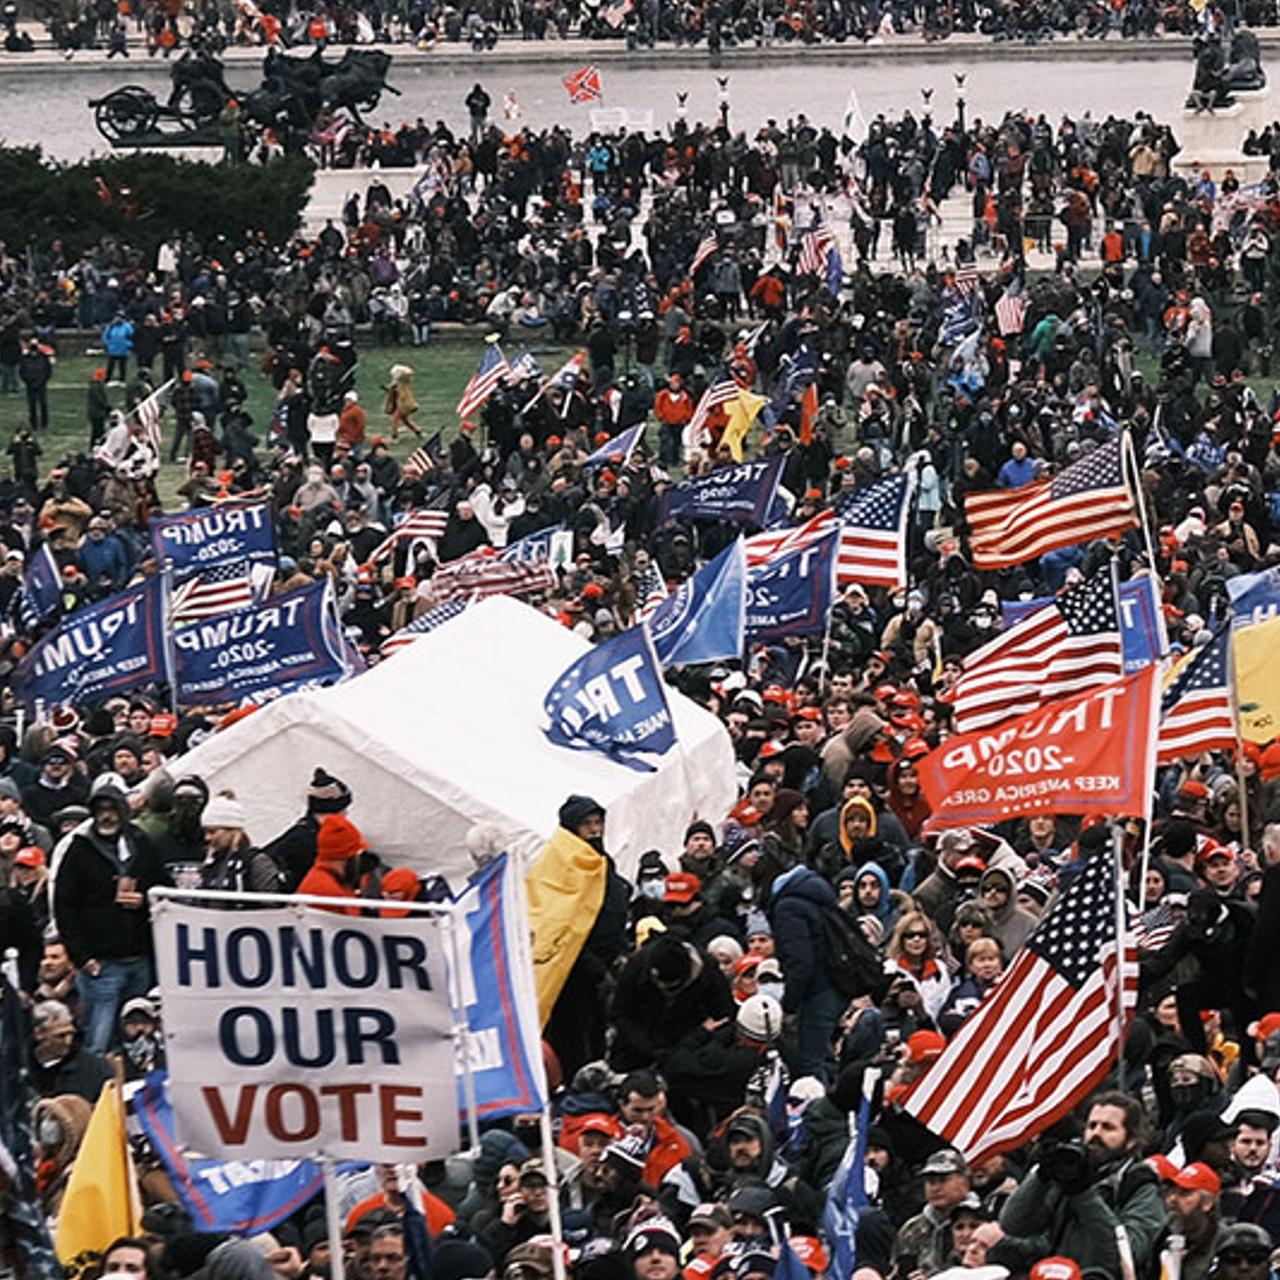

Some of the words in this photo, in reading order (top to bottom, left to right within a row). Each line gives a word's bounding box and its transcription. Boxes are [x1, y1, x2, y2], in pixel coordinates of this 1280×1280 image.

[175, 923, 433, 991] HONOR
[219, 1004, 402, 1070] OUR
[201, 1083, 429, 1148] VOTE
